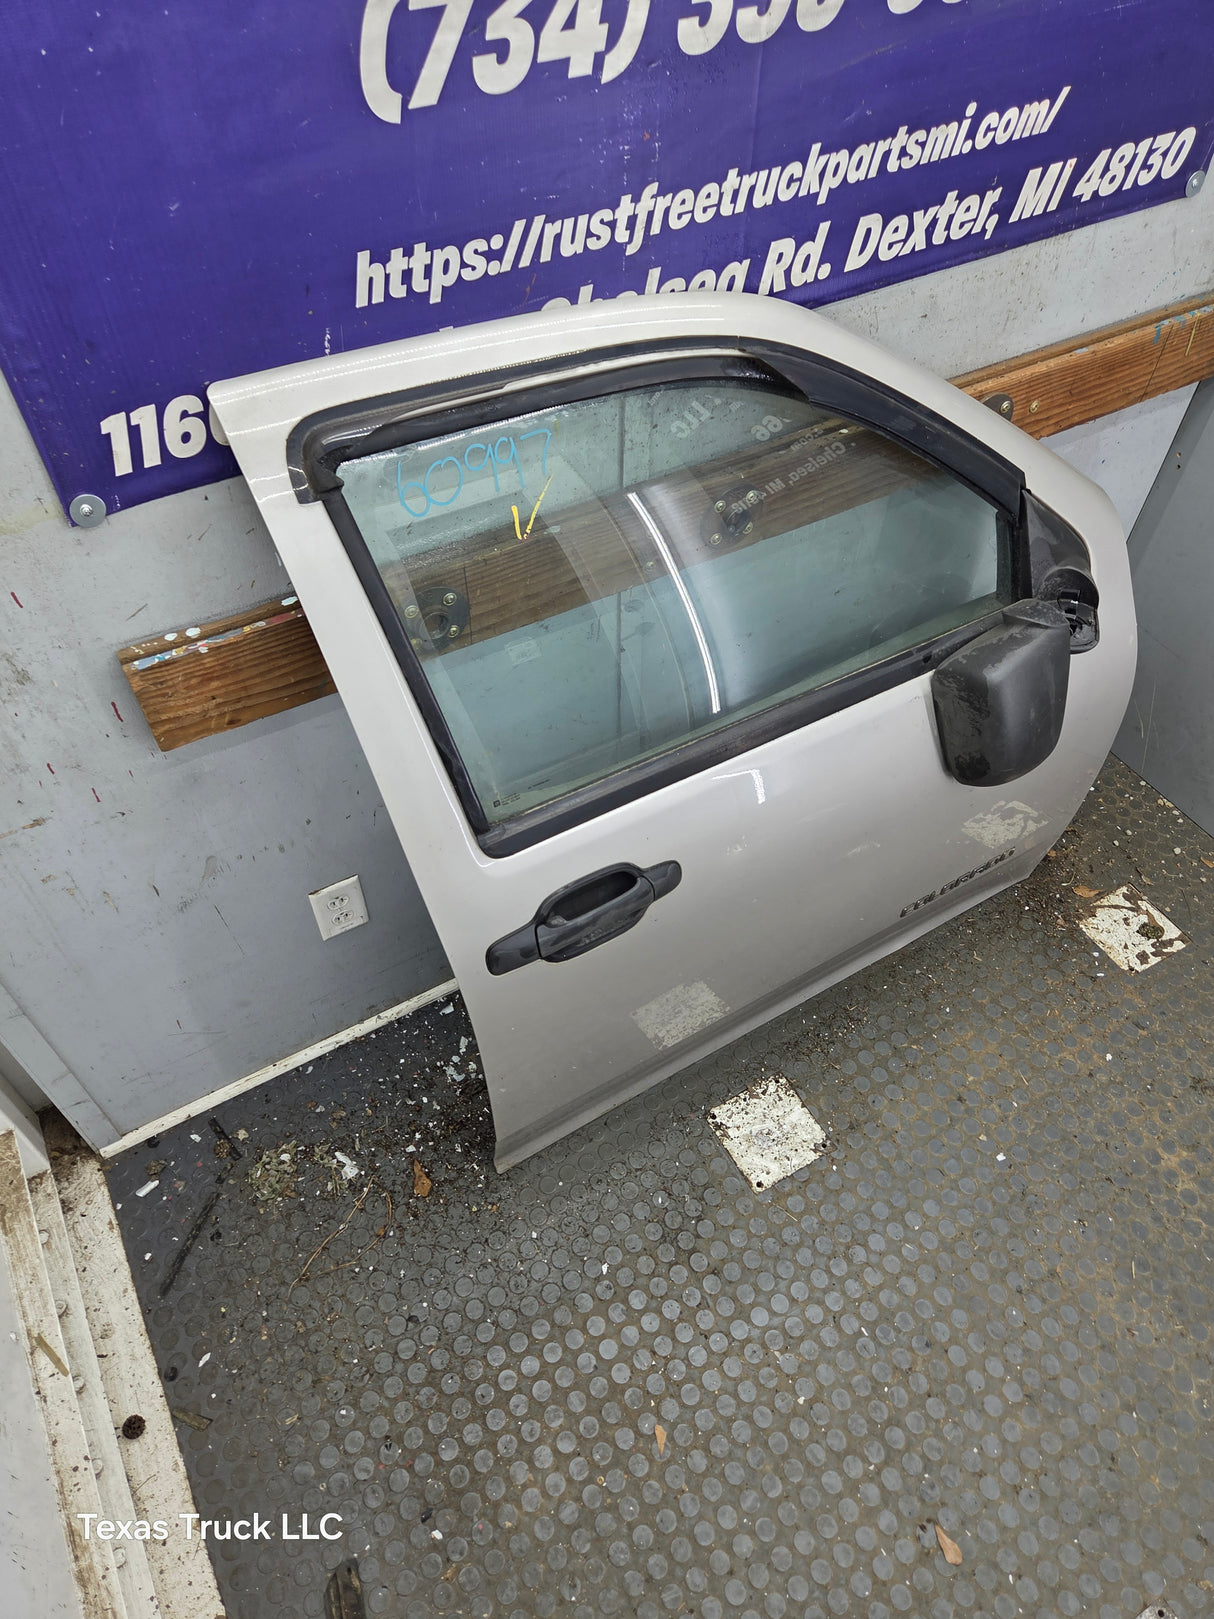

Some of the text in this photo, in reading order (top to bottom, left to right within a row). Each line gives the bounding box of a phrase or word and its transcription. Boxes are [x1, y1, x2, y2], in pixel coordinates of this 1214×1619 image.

[360, 0, 650, 124] (734)
[356, 86, 1071, 309] https://rustfreetruckpartsmi.com/
[758, 221, 831, 296] Rd.
[844, 187, 1002, 272] Dexter,
[1008, 158, 1077, 223] MI
[1072, 127, 1196, 202] 48130
[397, 428, 551, 518] 60997
